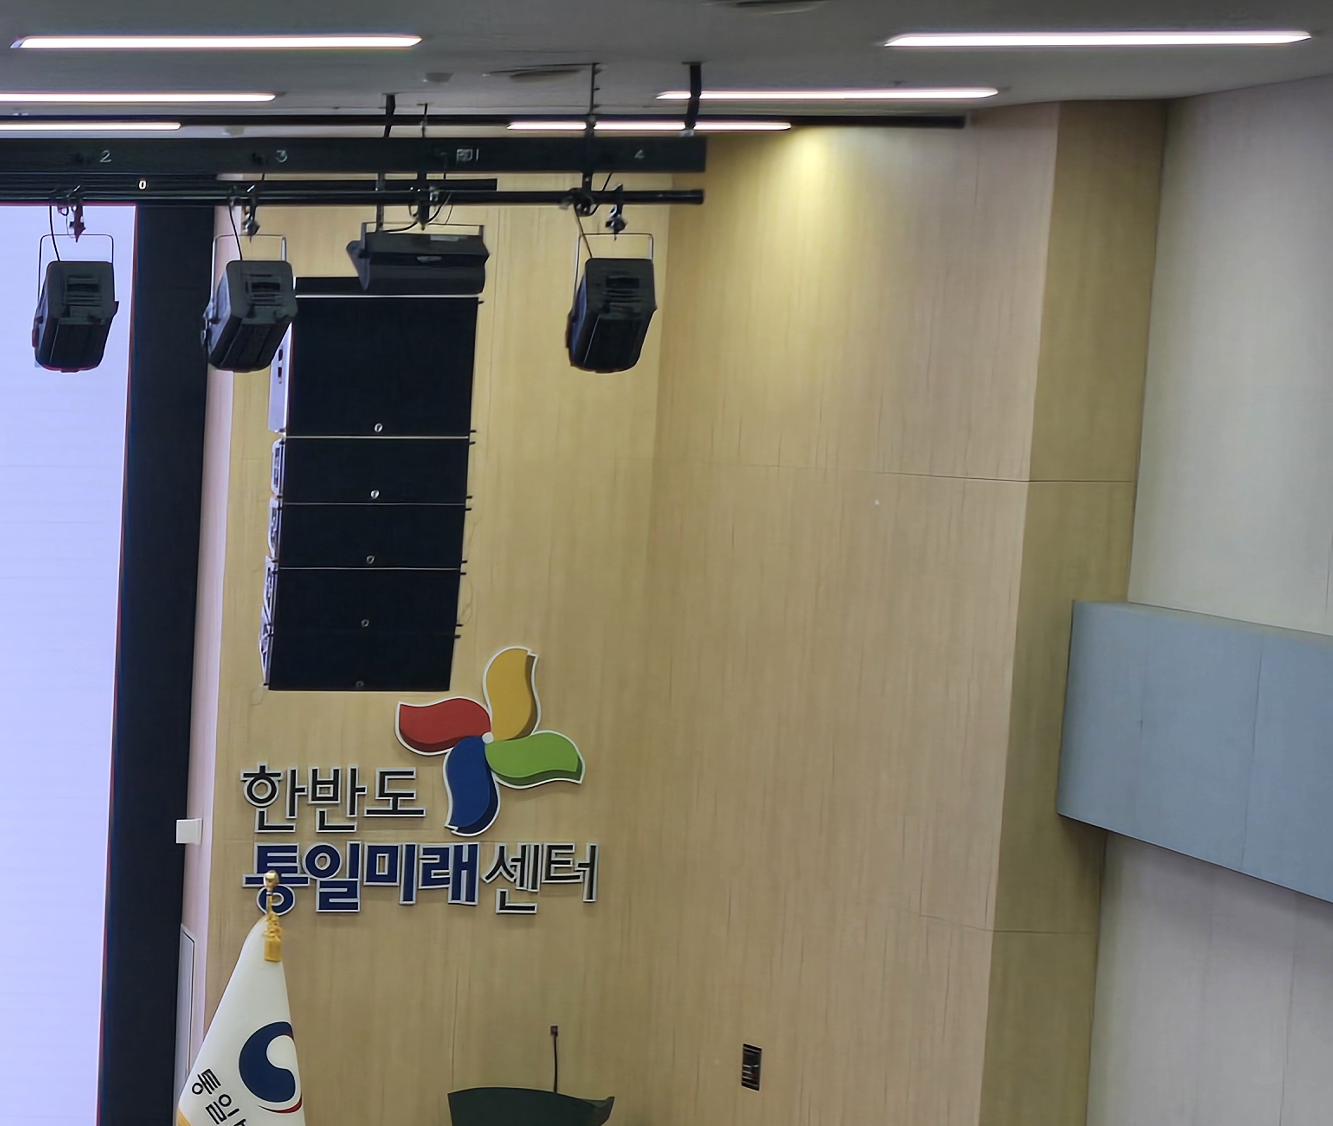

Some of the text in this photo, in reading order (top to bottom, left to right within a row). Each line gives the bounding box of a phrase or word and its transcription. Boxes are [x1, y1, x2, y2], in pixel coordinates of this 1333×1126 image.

[99, 149, 112, 163] 2
[275, 150, 288, 163] 3
[241, 761, 426, 833] 한반도
[242, 840, 600, 915] 통일미래센터
